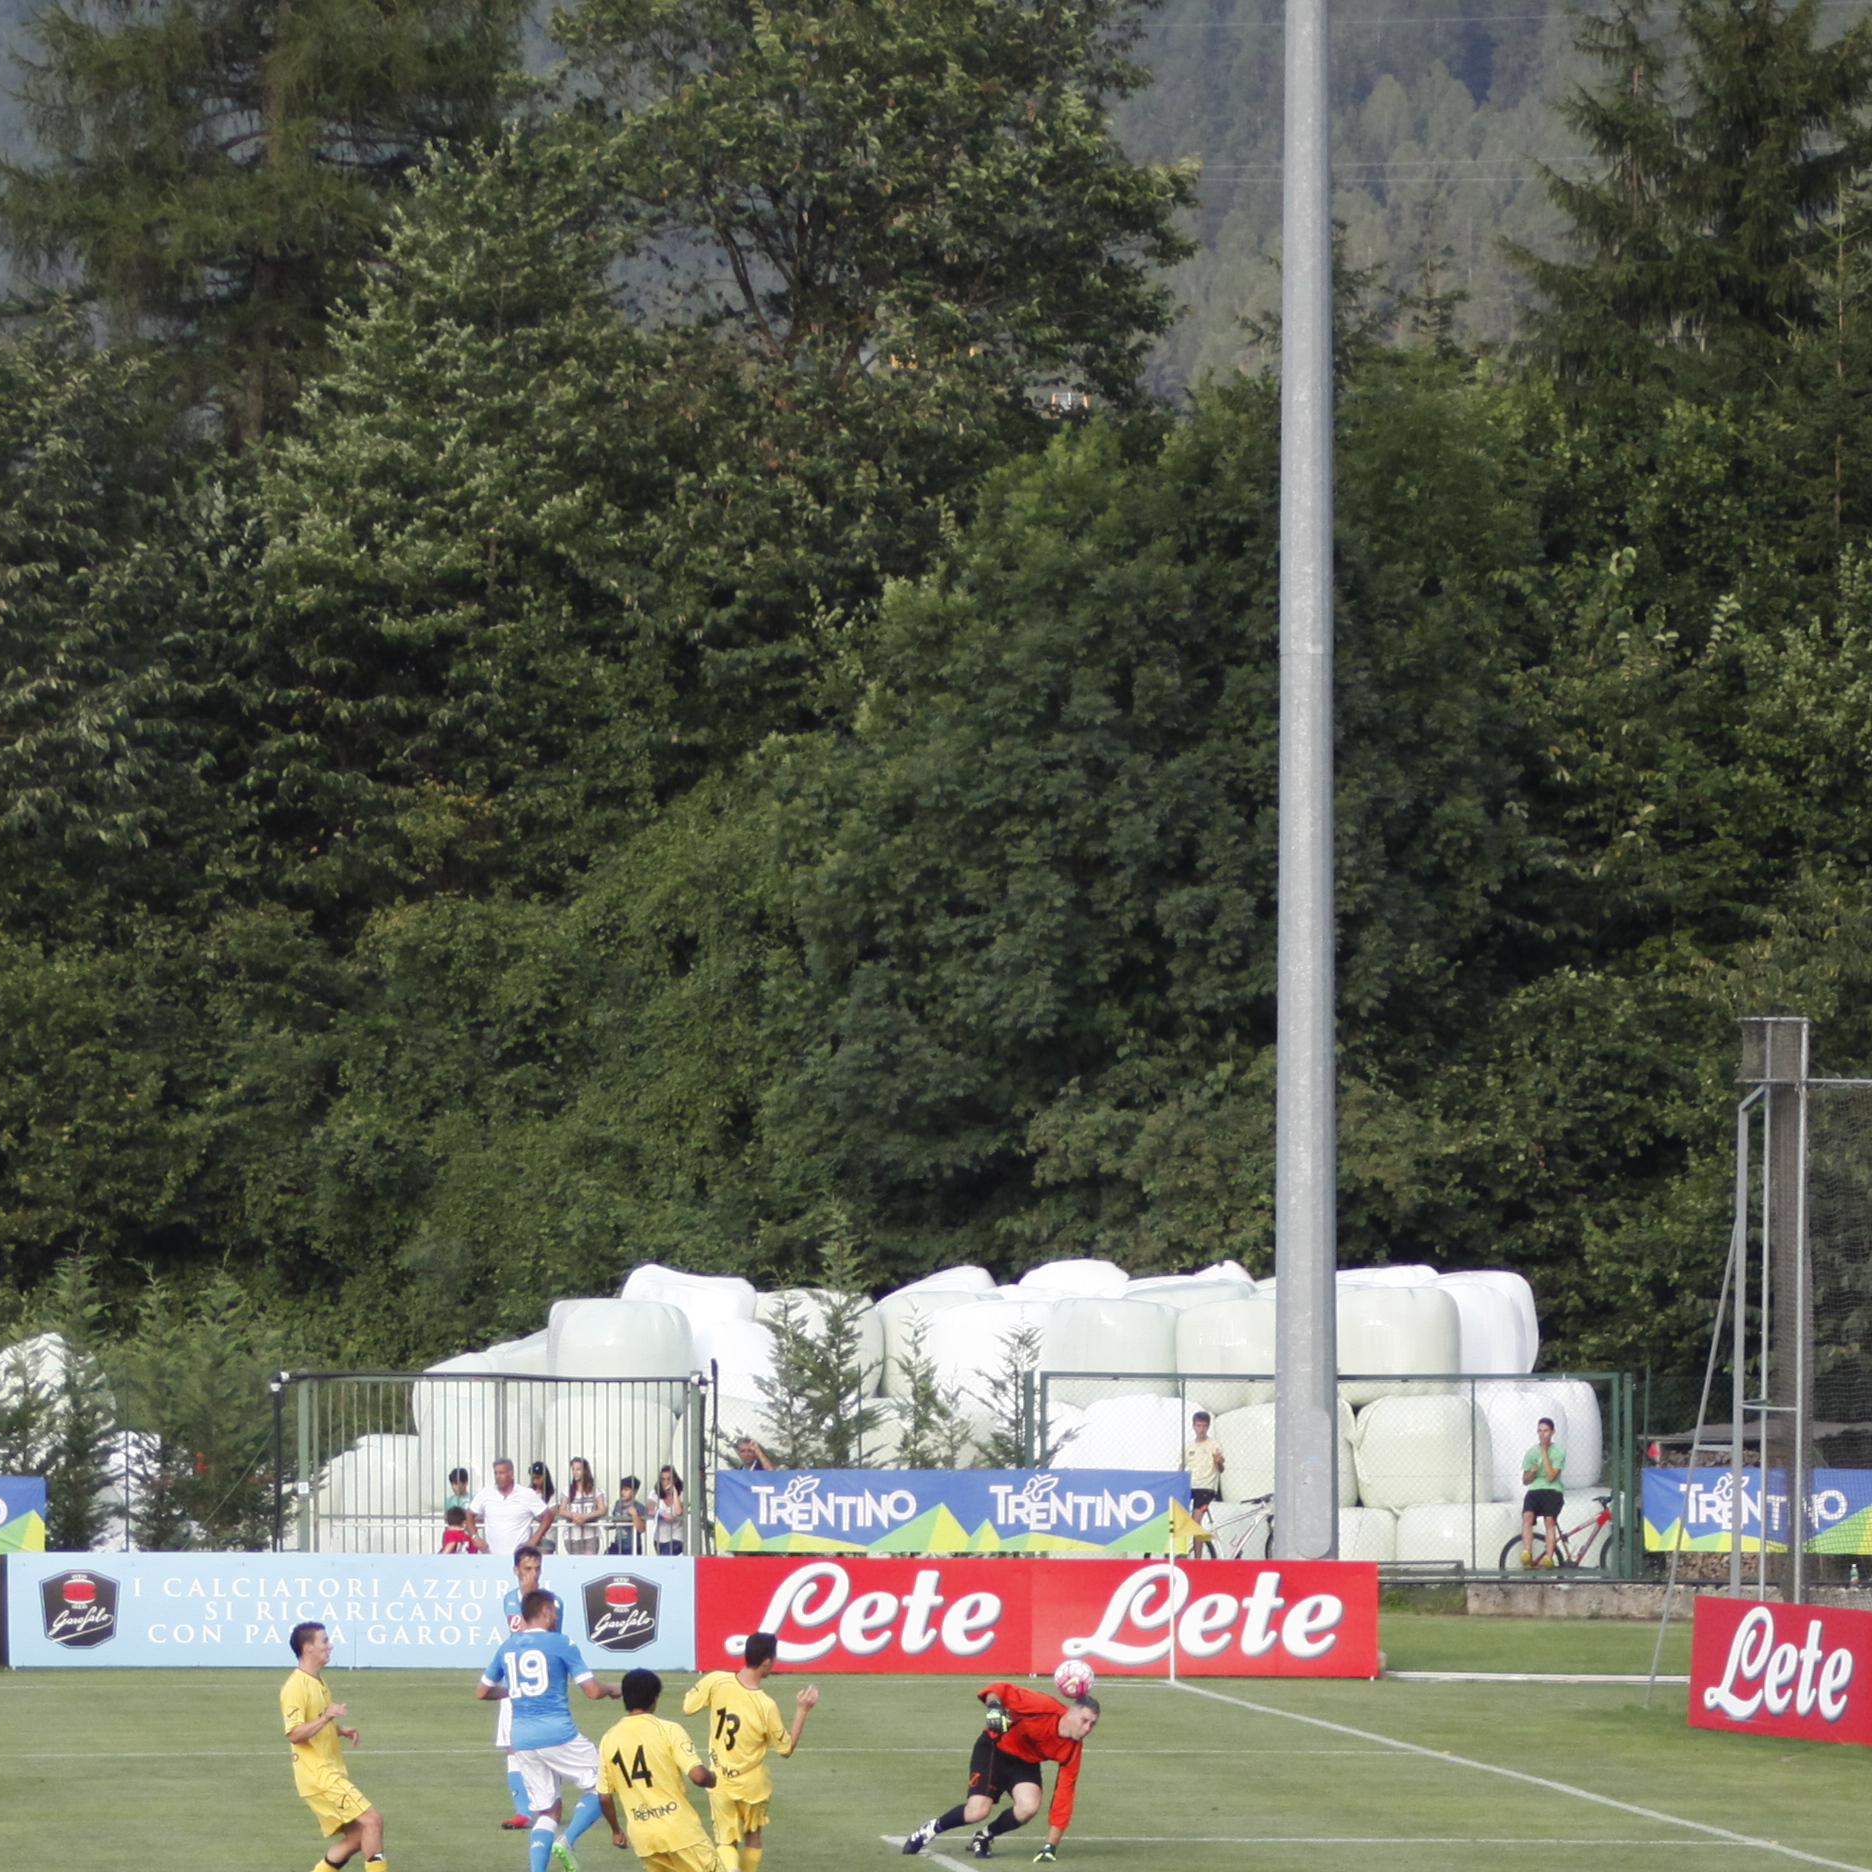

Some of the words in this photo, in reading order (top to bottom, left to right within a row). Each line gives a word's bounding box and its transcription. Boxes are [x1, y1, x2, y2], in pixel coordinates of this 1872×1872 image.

[750, 1485, 918, 1532] TRENTINO
[989, 1484, 1155, 1532] TRENTINO
[134, 1577, 142, 1598] I
[163, 1577, 380, 1599] CALCIATORI
[399, 1578, 552, 1600] AZZURI
[48, 1605, 113, 1636] Garofalo
[205, 1601, 233, 1622] SI
[257, 1601, 483, 1622] RICARICANO
[590, 1609, 655, 1640] Garofalo
[724, 1561, 1003, 1664] Lete
[1061, 1562, 1344, 1666] Lete
[147, 1623, 223, 1645] CON
[245, 1624, 347, 1645] PAA
[367, 1624, 506, 1646] GAROFA
[503, 1649, 550, 1700] 19
[1703, 1605, 1854, 1722] Lete
[716, 1707, 741, 1751] 13
[611, 1744, 653, 1789] 14
[631, 1801, 678, 1822] TRENTINO
